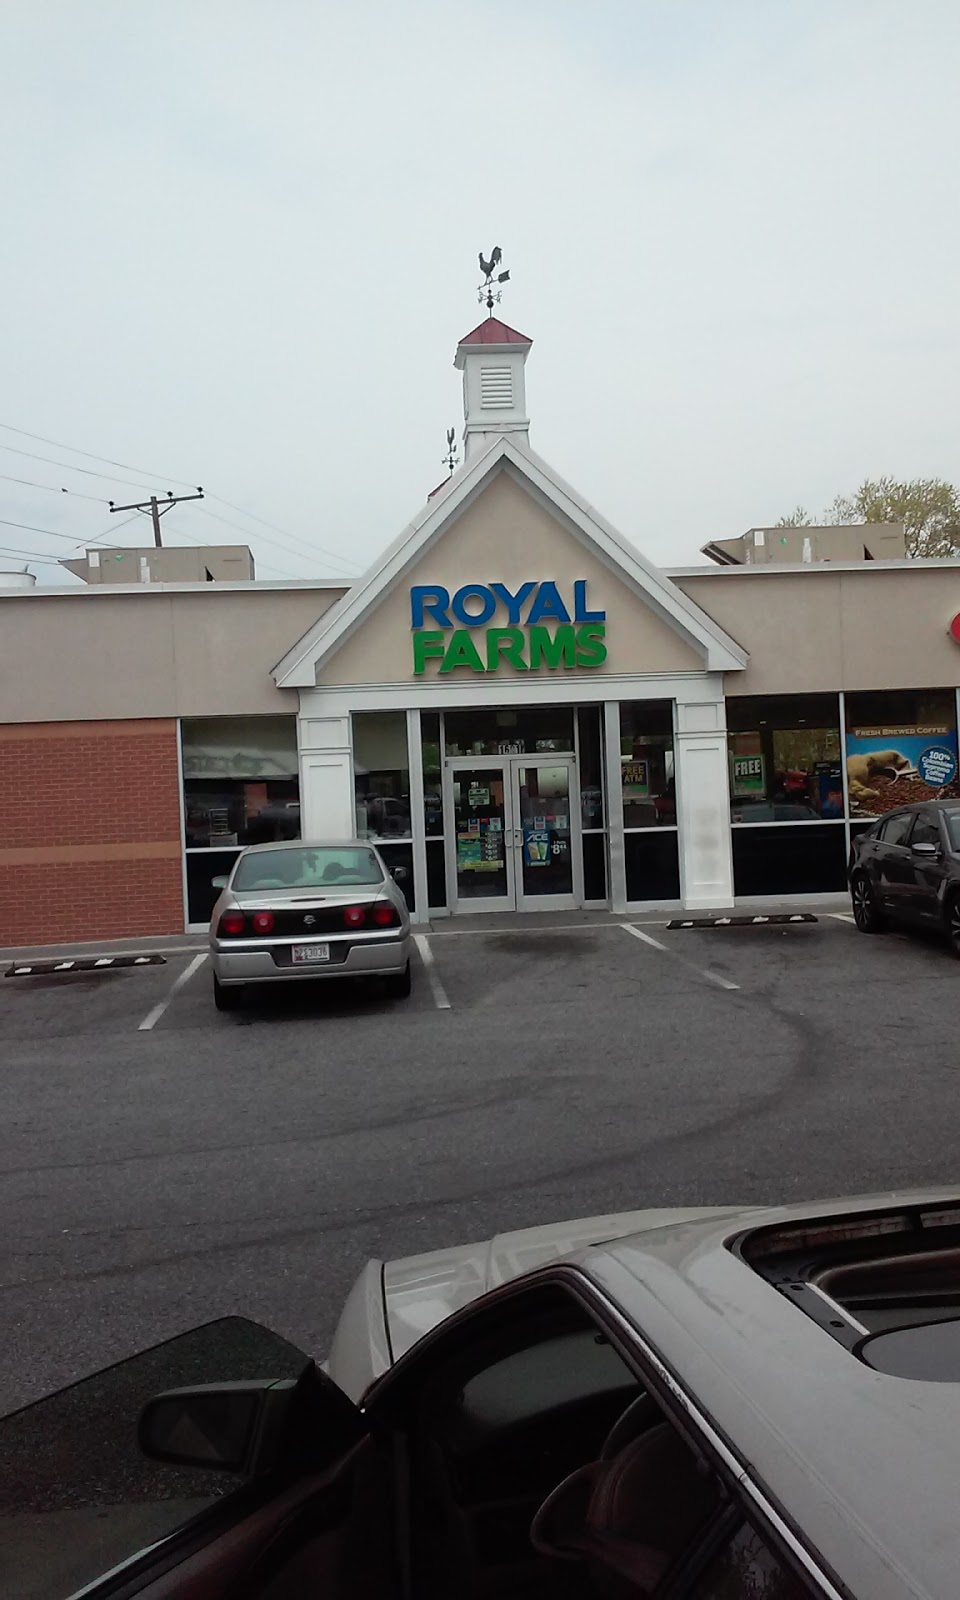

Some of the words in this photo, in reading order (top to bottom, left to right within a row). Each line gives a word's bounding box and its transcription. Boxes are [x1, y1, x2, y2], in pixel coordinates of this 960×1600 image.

[410, 580, 606, 629] ROYAL
[412, 625, 607, 675] FARMS
[855, 729, 881, 737] FRESH
[882, 728, 916, 736] BREWED
[916, 726, 948, 735] COFFEE
[929, 750, 950, 761] 100%
[621, 766, 645, 776] FREE
[735, 759, 761, 776] FREE
[624, 774, 644, 783] ATM
